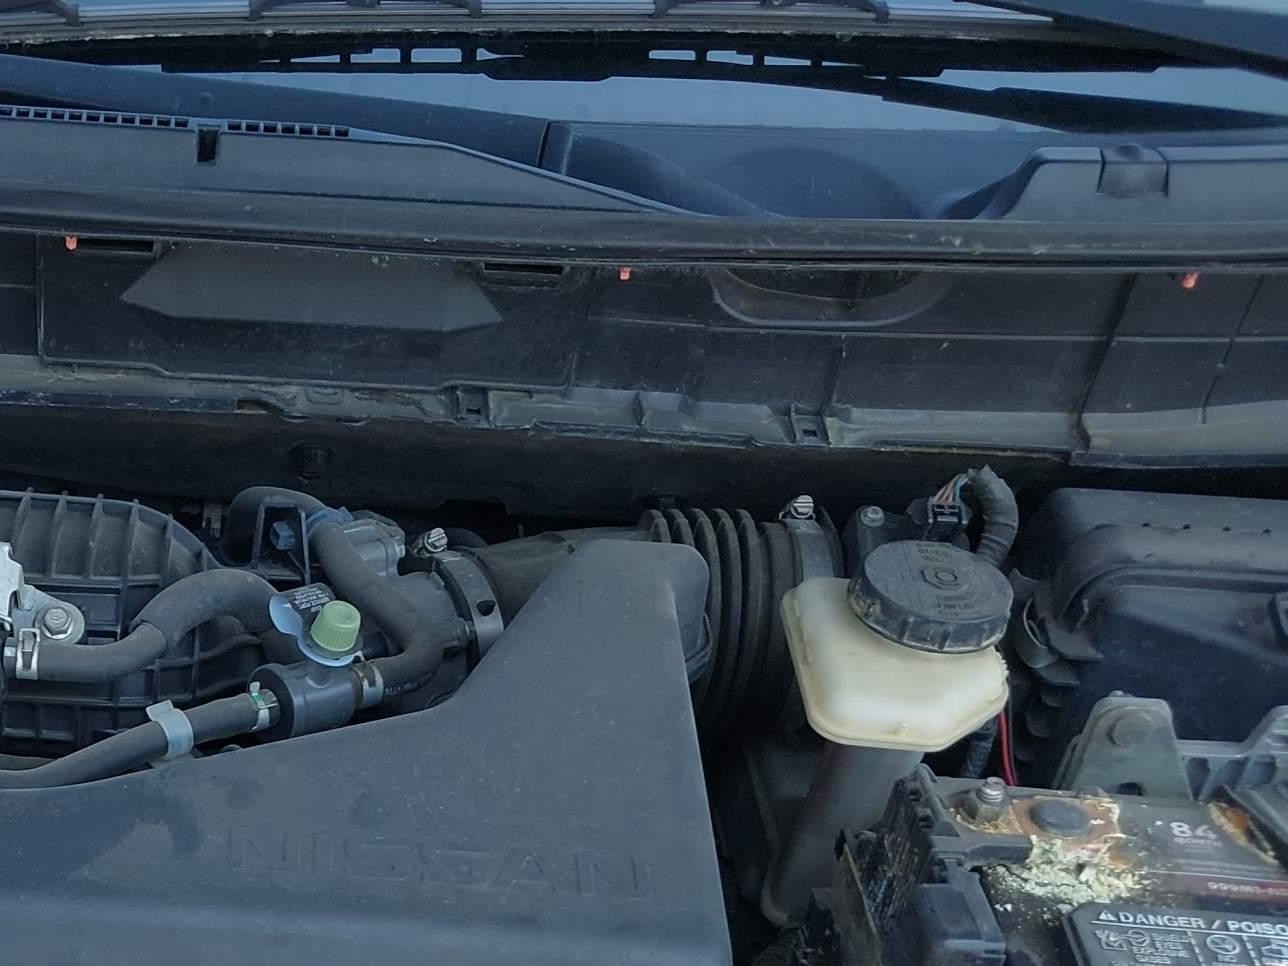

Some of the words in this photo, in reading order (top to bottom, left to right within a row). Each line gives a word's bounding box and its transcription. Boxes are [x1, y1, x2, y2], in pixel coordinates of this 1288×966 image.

[1169, 821, 1218, 840] 84
[225, 825, 658, 904] NISSAN
[1118, 911, 1206, 929] DANGER
